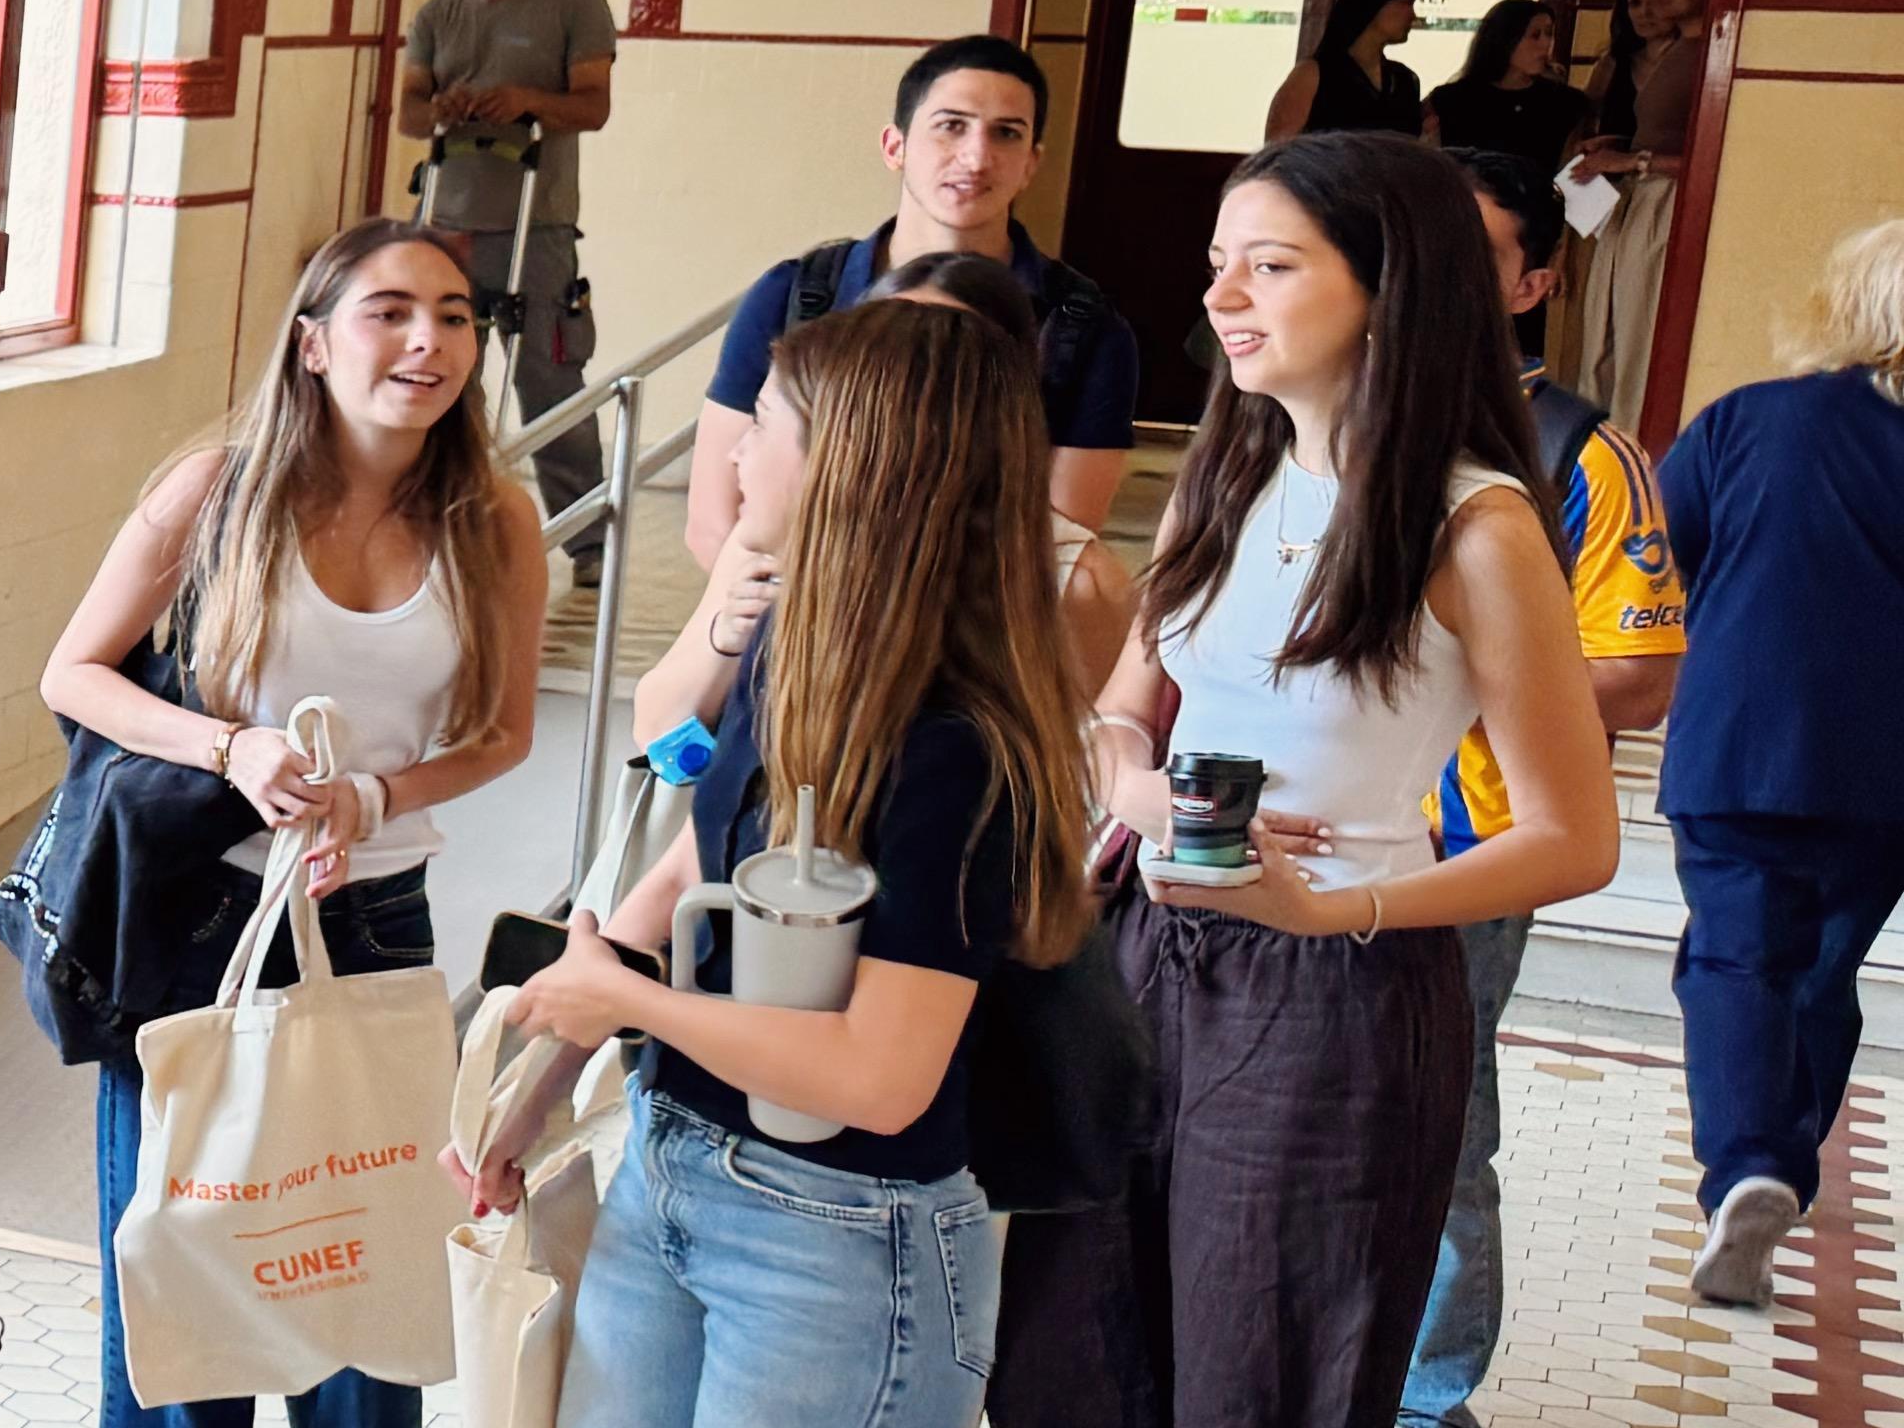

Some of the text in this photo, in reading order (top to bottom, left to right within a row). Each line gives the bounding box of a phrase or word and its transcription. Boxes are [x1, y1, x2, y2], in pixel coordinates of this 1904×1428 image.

[168, 1176, 271, 1202] Master
[324, 1143, 418, 1180] future
[253, 1239, 365, 1286] CUNEF
